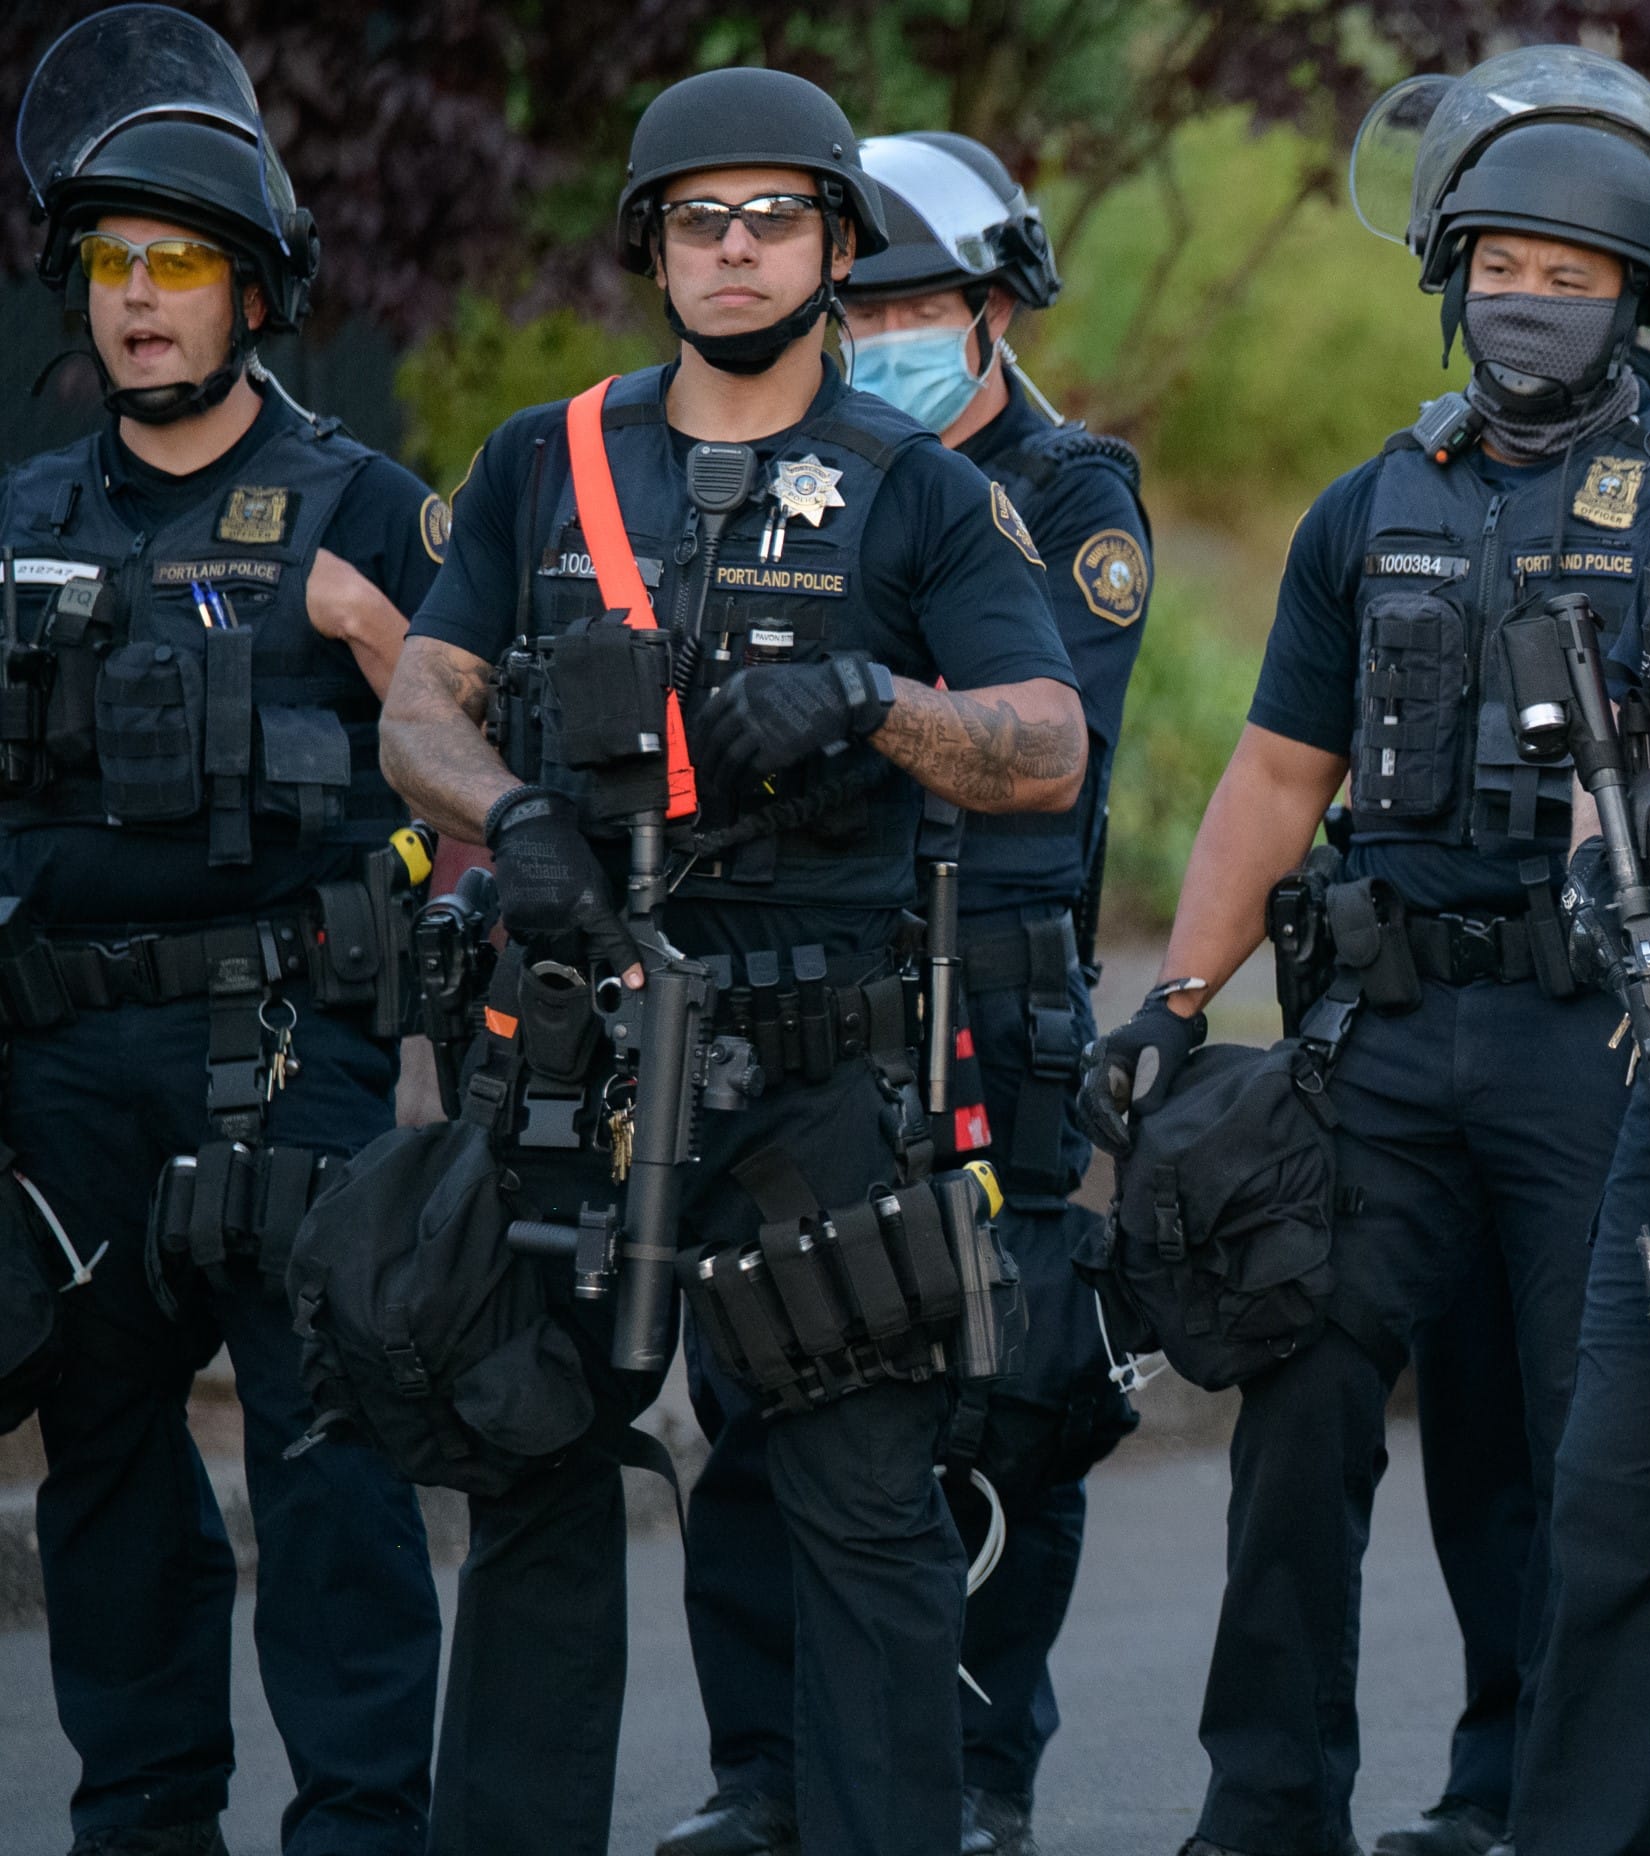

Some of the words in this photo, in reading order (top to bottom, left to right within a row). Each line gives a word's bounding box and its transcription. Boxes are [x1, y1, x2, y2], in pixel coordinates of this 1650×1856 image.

[159, 563, 226, 580] PORTLAND
[228, 561, 276, 579] POLICE
[1380, 554, 1441, 575] 1000384
[1585, 553, 1633, 574] POLICE
[717, 567, 791, 588] PORTLAND
[793, 572, 844, 592] POLICE
[67, 588, 92, 608] TQ
